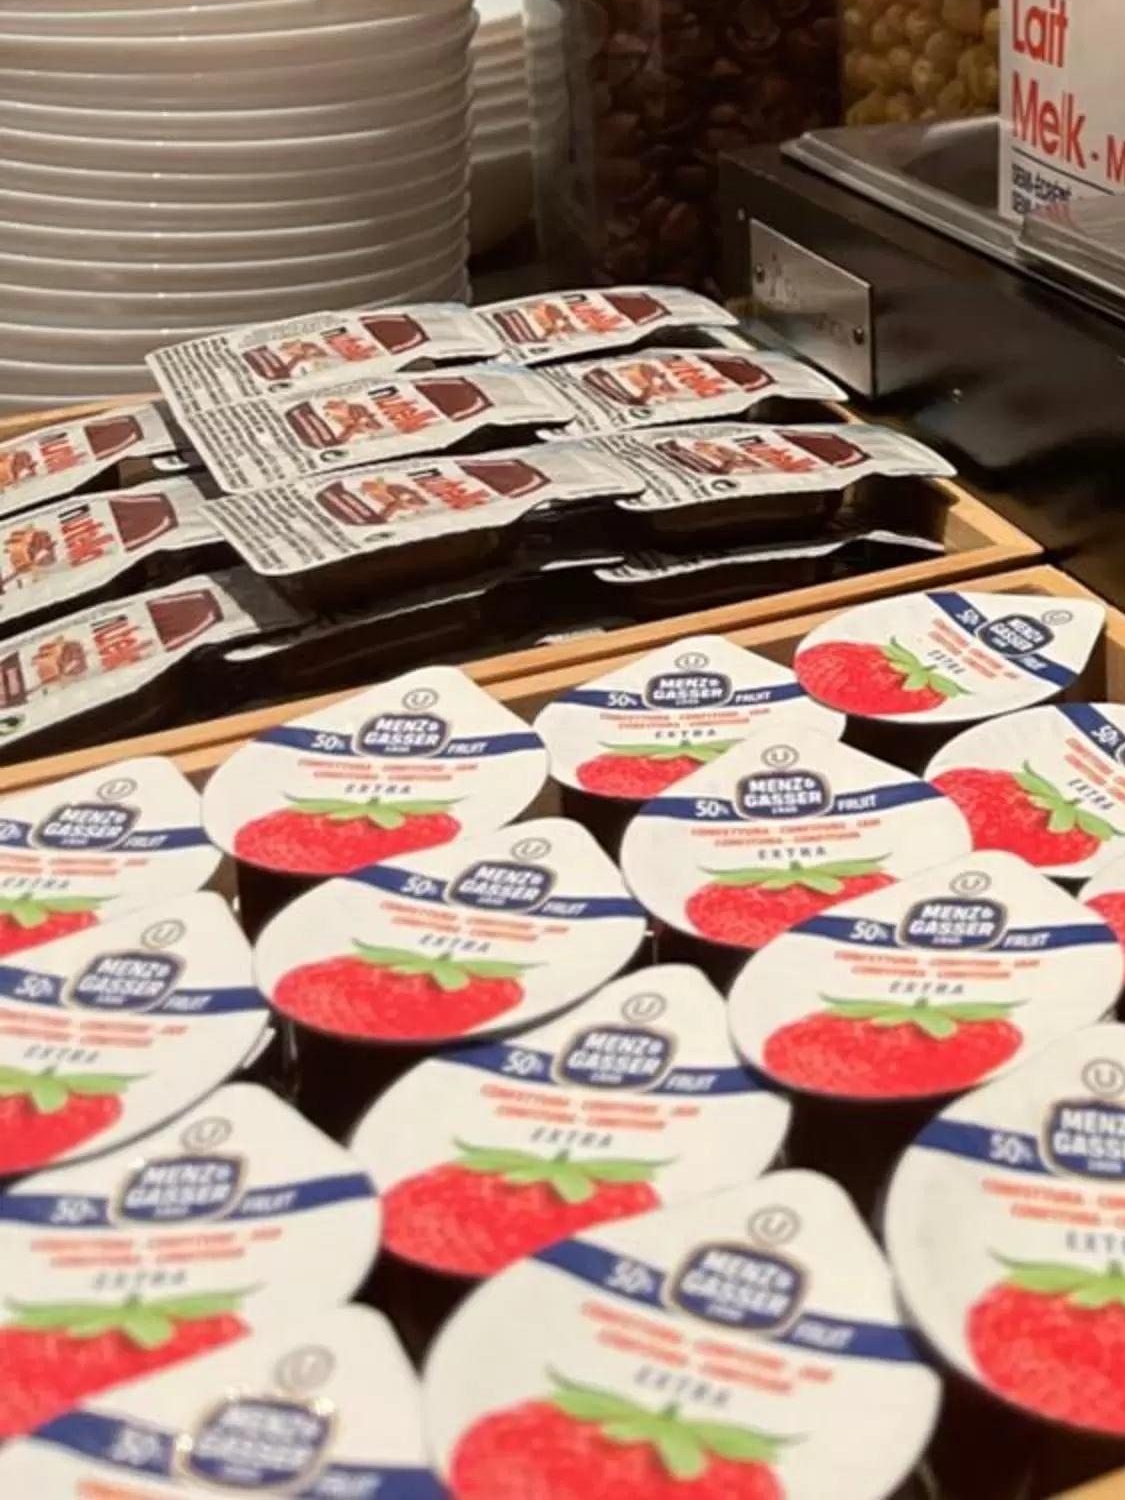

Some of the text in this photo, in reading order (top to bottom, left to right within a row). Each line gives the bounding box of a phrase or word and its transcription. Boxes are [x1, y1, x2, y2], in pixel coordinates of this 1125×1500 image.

[1012, 70, 1086, 169] Melk
[364, 730, 440, 746] GASSER
[744, 791, 821, 808] GASSER
[837, 795, 877, 812] FRUIT
[757, 846, 827, 860] EXTRA
[459, 880, 540, 902] GASSER
[908, 919, 995, 937] GASSER
[1003, 932, 1049, 948] FRUIT
[888, 980, 965, 995] EXTRA
[568, 1049, 660, 1075] GASSER
[664, 1073, 718, 1092] FRUIT
[530, 1127, 613, 1149] EXTRA
